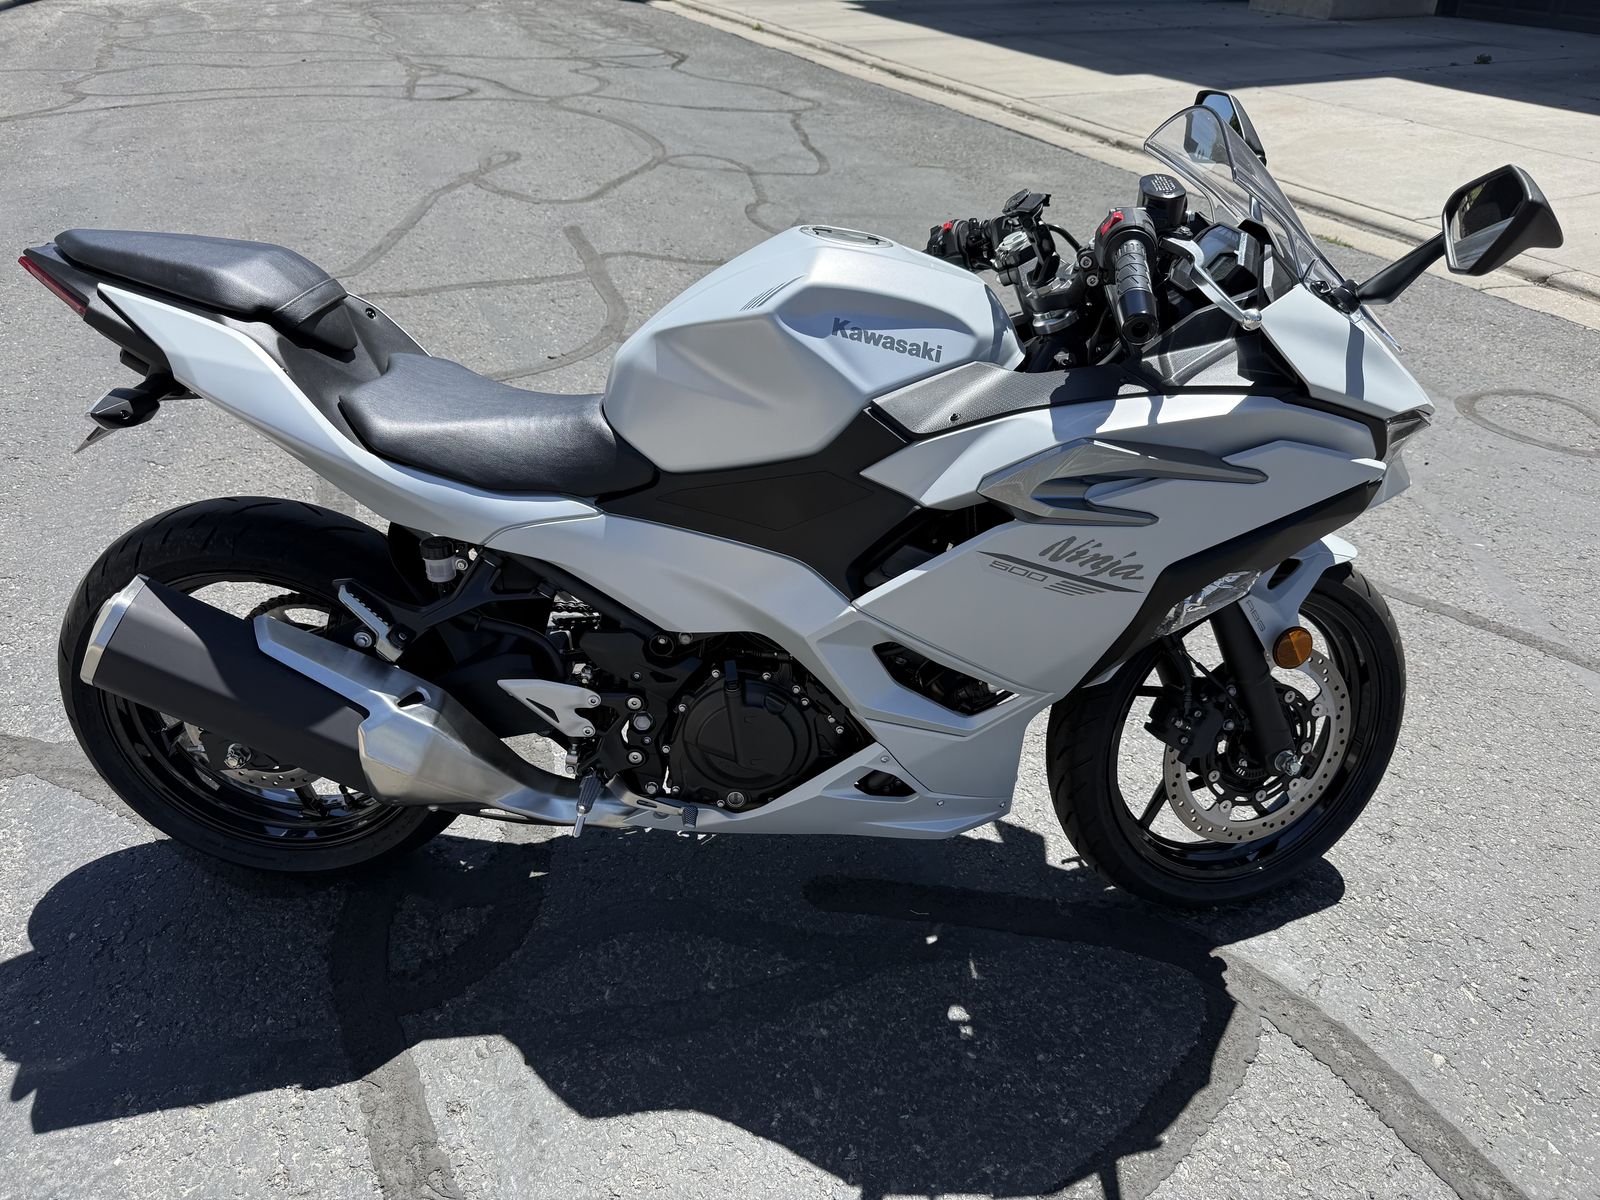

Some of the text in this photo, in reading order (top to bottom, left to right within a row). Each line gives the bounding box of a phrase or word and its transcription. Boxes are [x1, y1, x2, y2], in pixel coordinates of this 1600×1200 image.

[831, 317, 943, 363] Kawasaki
[989, 559, 1049, 583] 500
[1038, 535, 1145, 580] Ninja
[1245, 599, 1266, 632] ABS
